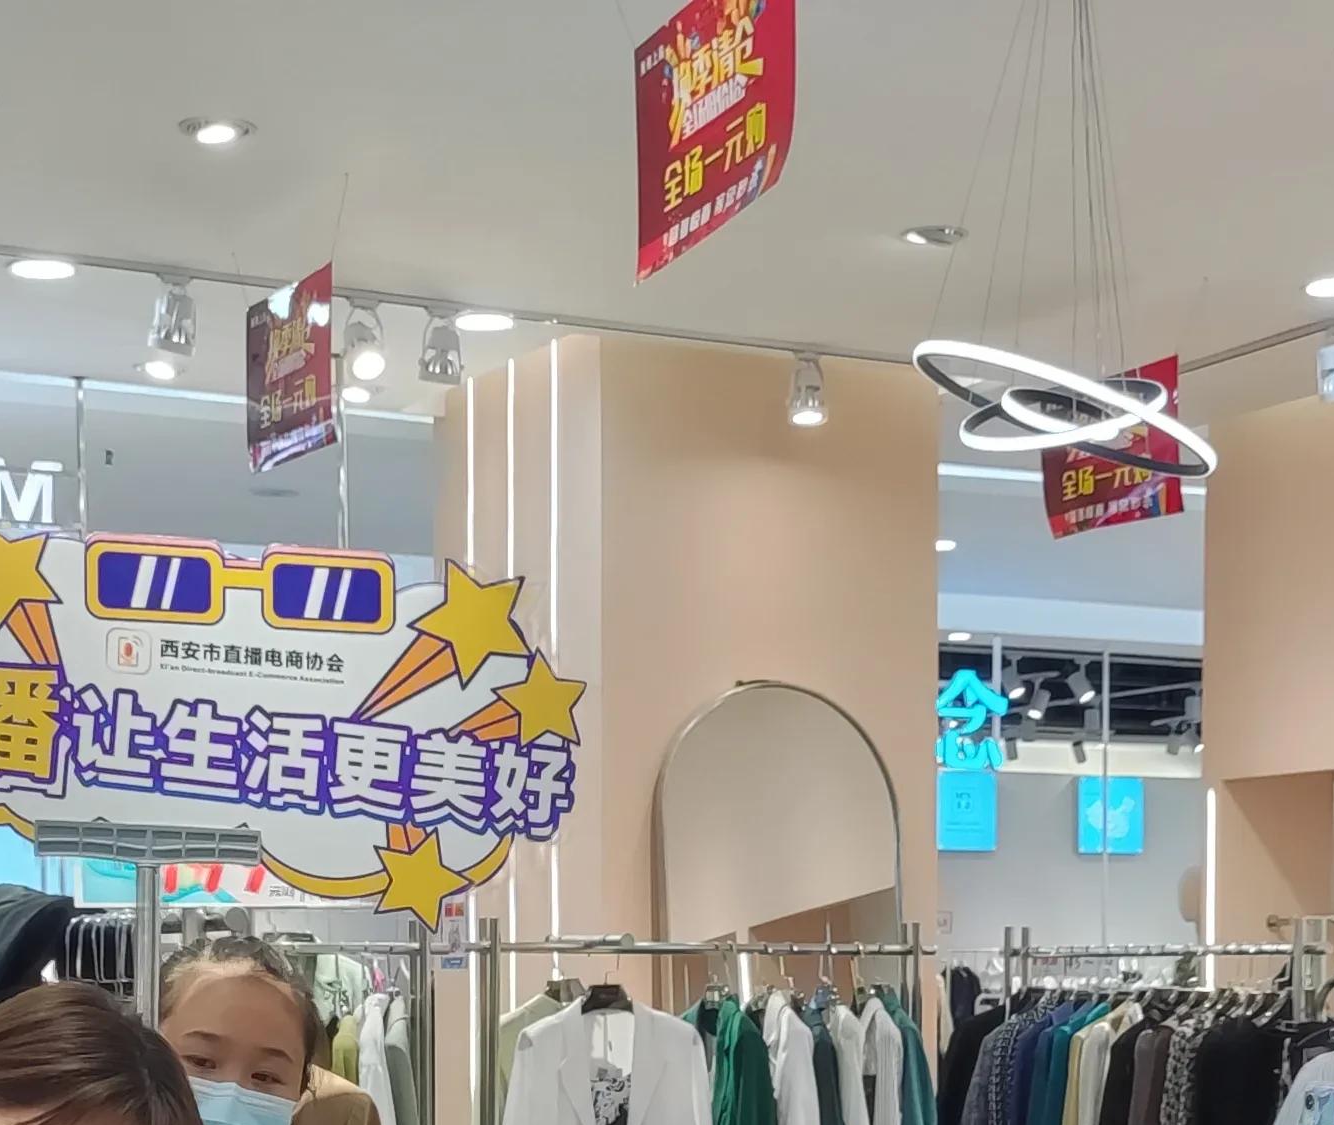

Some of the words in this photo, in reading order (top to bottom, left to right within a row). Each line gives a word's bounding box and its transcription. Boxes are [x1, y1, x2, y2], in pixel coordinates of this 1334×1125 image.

[663, 102, 766, 212] 全场一元购
[160, 639, 345, 672] 西安市直播电商协会
[248, 671, 297, 681] E-Commerce
